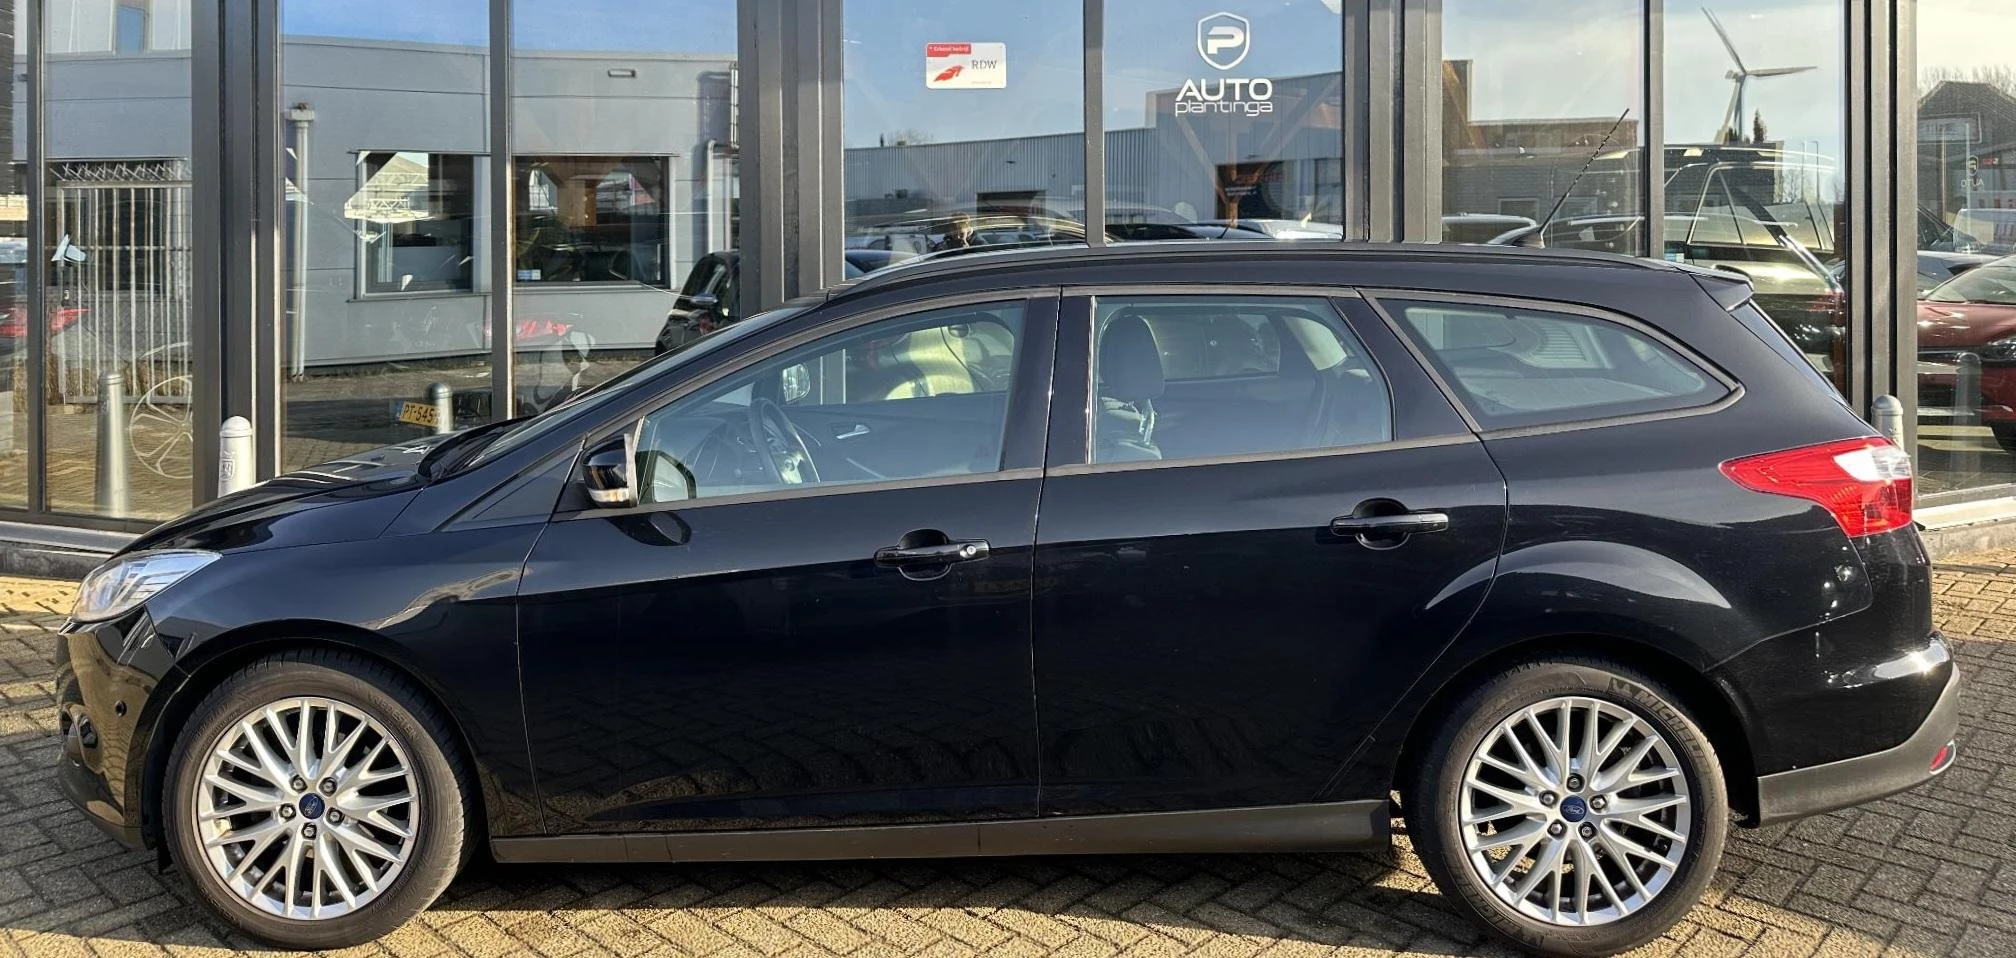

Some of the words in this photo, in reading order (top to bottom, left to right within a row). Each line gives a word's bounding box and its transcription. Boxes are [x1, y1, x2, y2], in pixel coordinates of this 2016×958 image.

[1207, 26, 1244, 54] P
[972, 59, 997, 70] RDW
[1175, 78, 1272, 101] AUTO
[1175, 100, 1273, 117] plantinga
[402, 404, 438, 424] PT-545-
[1634, 688, 1712, 776] MICHELIN
